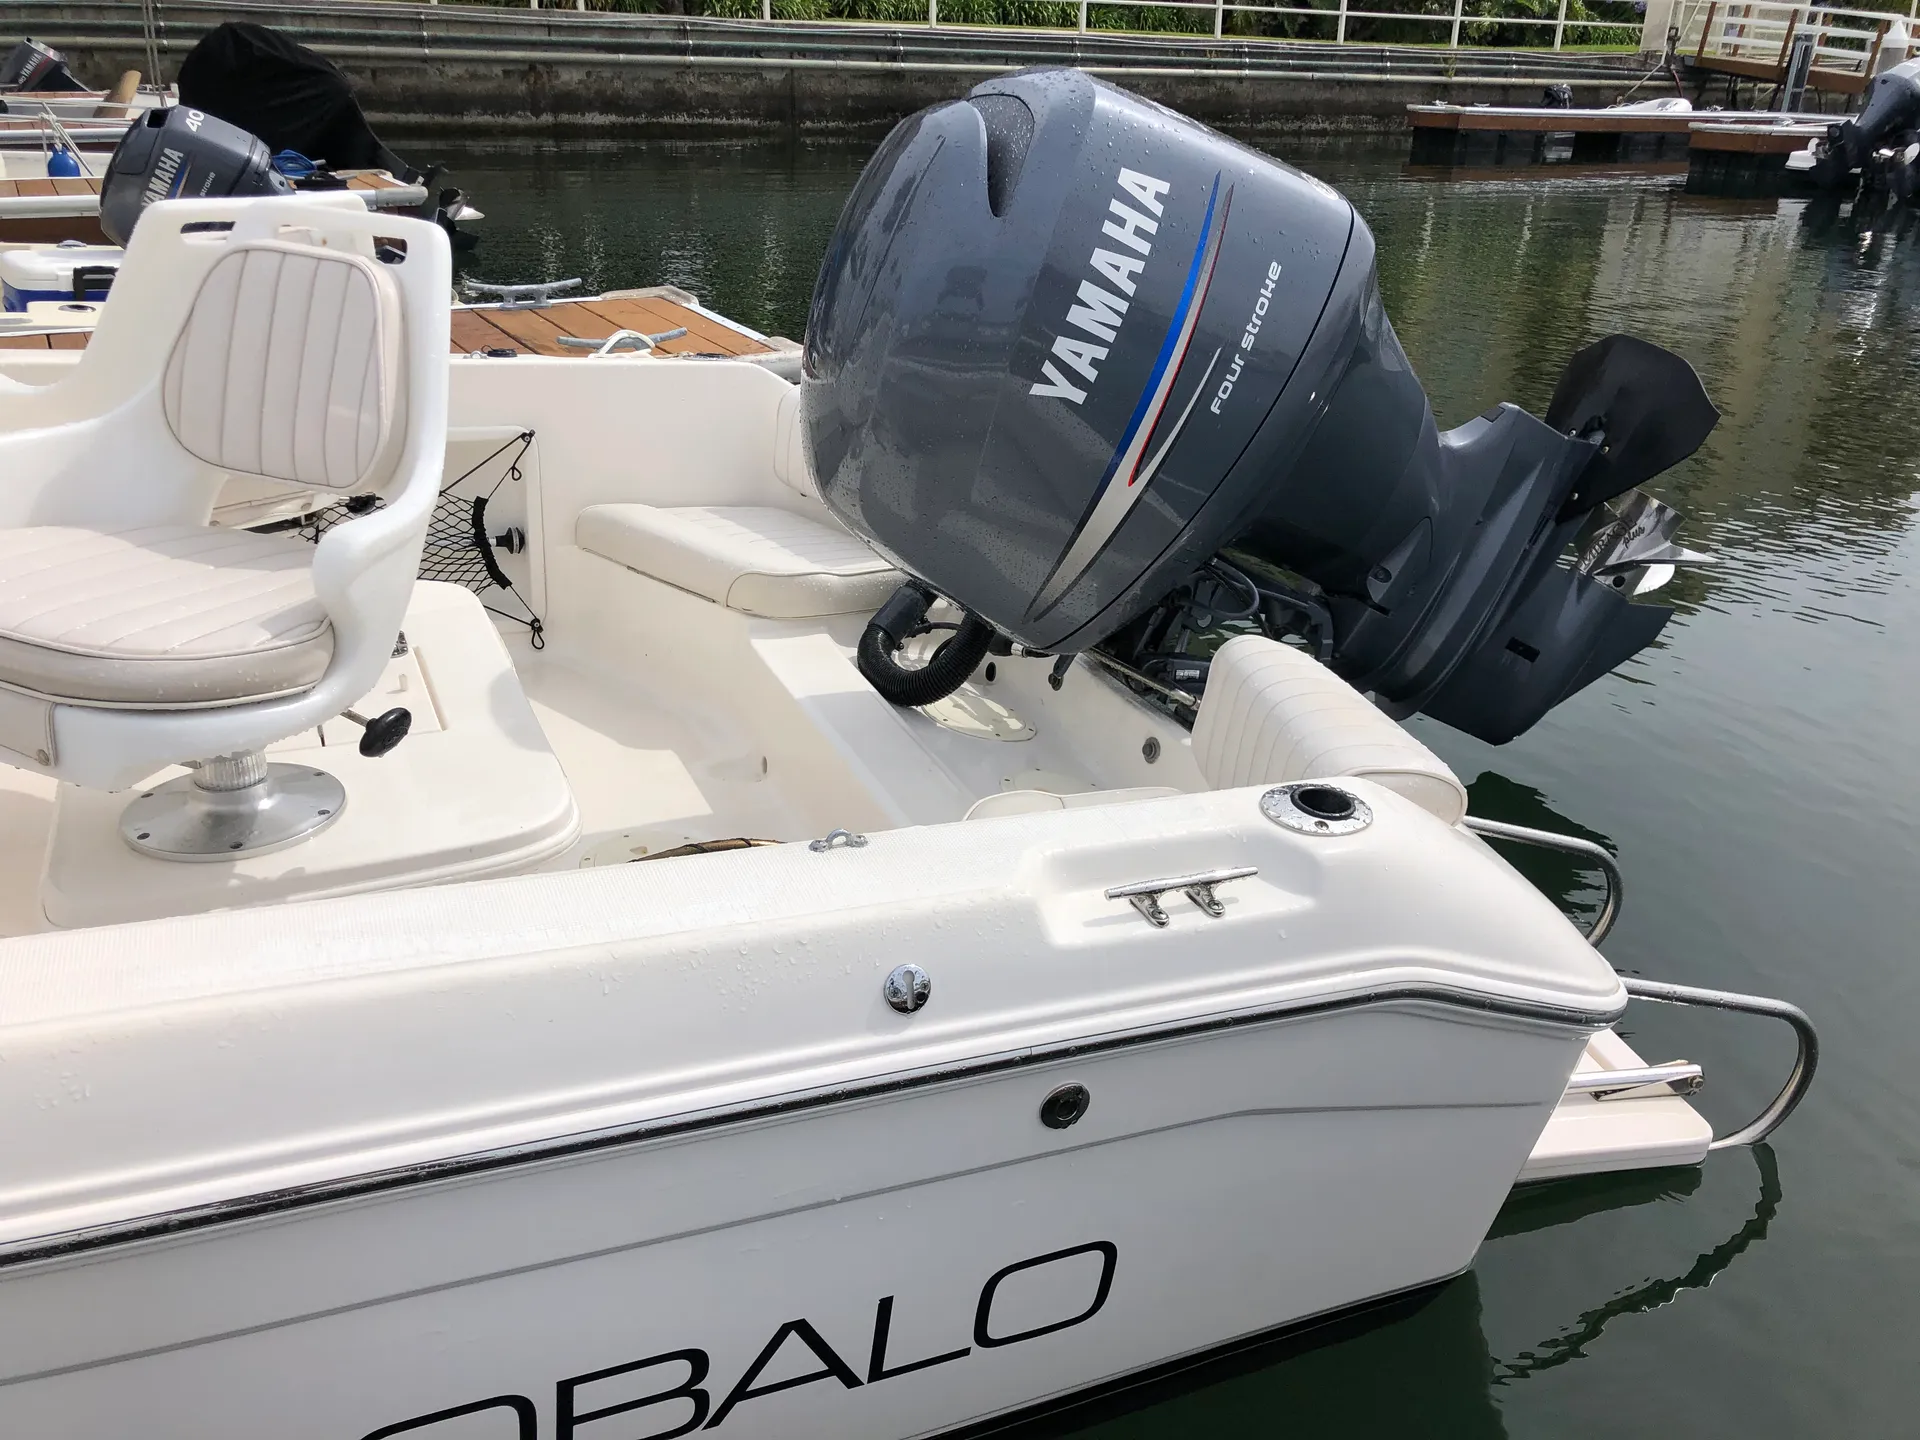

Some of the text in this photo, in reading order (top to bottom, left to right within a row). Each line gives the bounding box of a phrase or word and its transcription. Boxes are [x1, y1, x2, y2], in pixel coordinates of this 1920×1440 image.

[20, 53, 42, 77] YAMAHA
[186, 110, 204, 132] 40
[1029, 167, 1171, 405] YAMAHA
